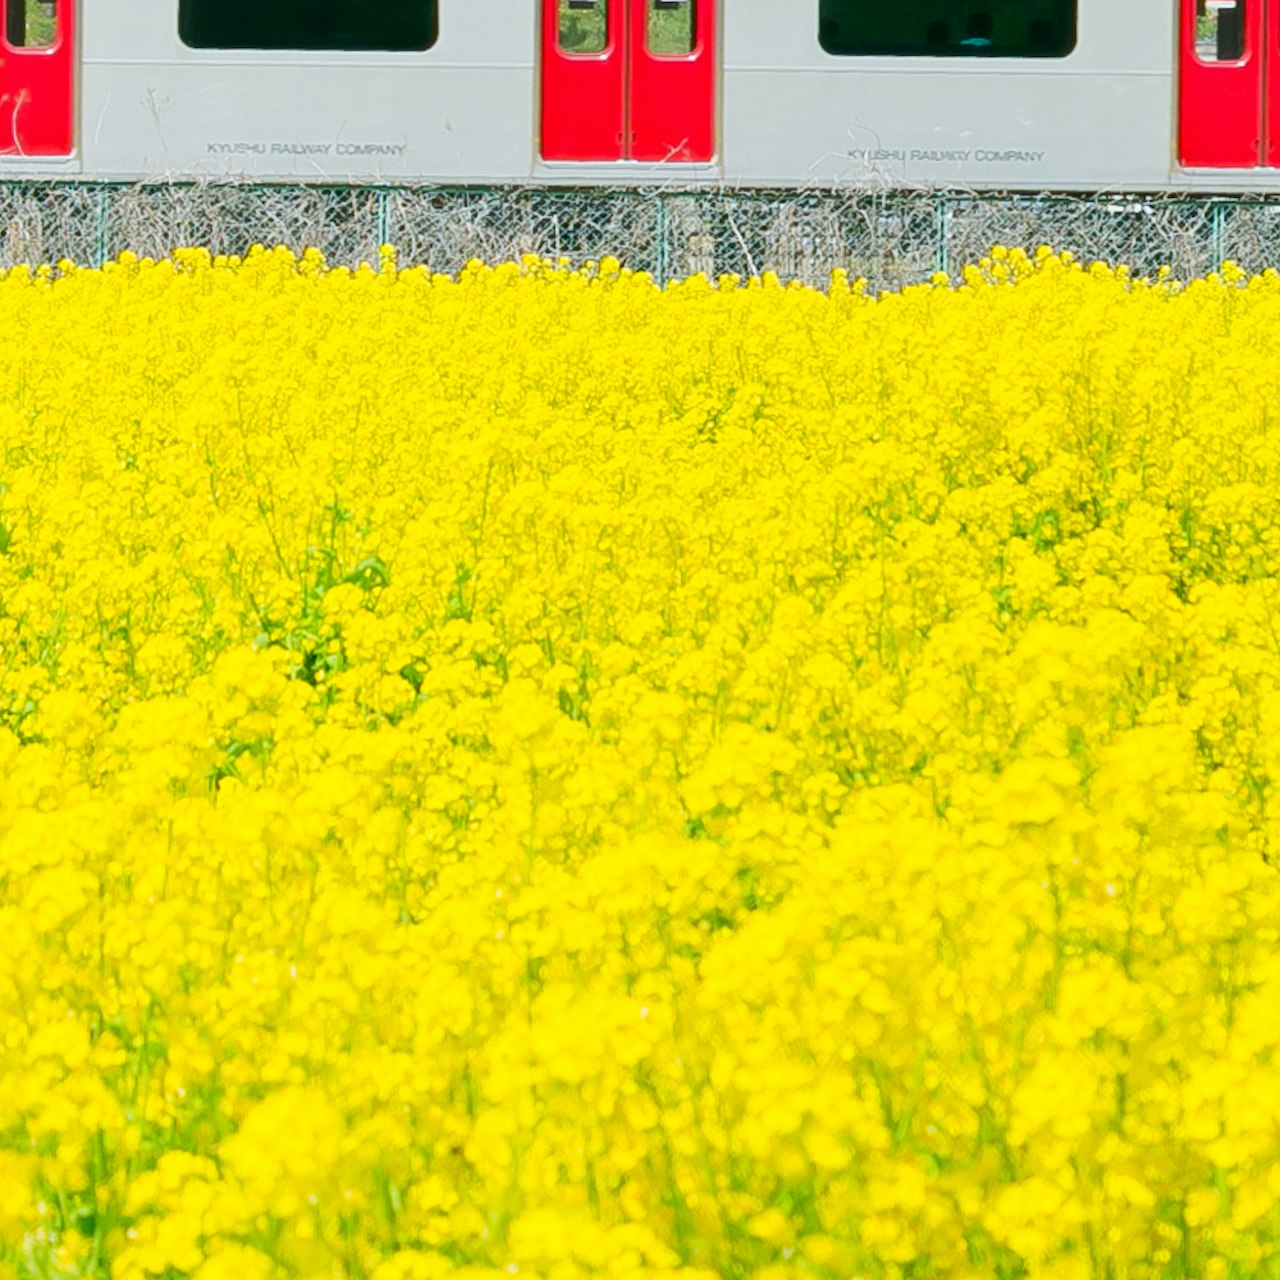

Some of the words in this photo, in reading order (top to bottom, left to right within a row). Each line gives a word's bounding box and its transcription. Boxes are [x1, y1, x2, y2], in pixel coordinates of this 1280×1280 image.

[207, 143, 266, 154] KYUSHU
[271, 143, 333, 155] RAILWAY
[335, 143, 407, 156] COMPANY
[848, 149, 906, 161] KYUSHU
[910, 149, 972, 162] RAILWAY
[974, 149, 1045, 162] COMPANY
